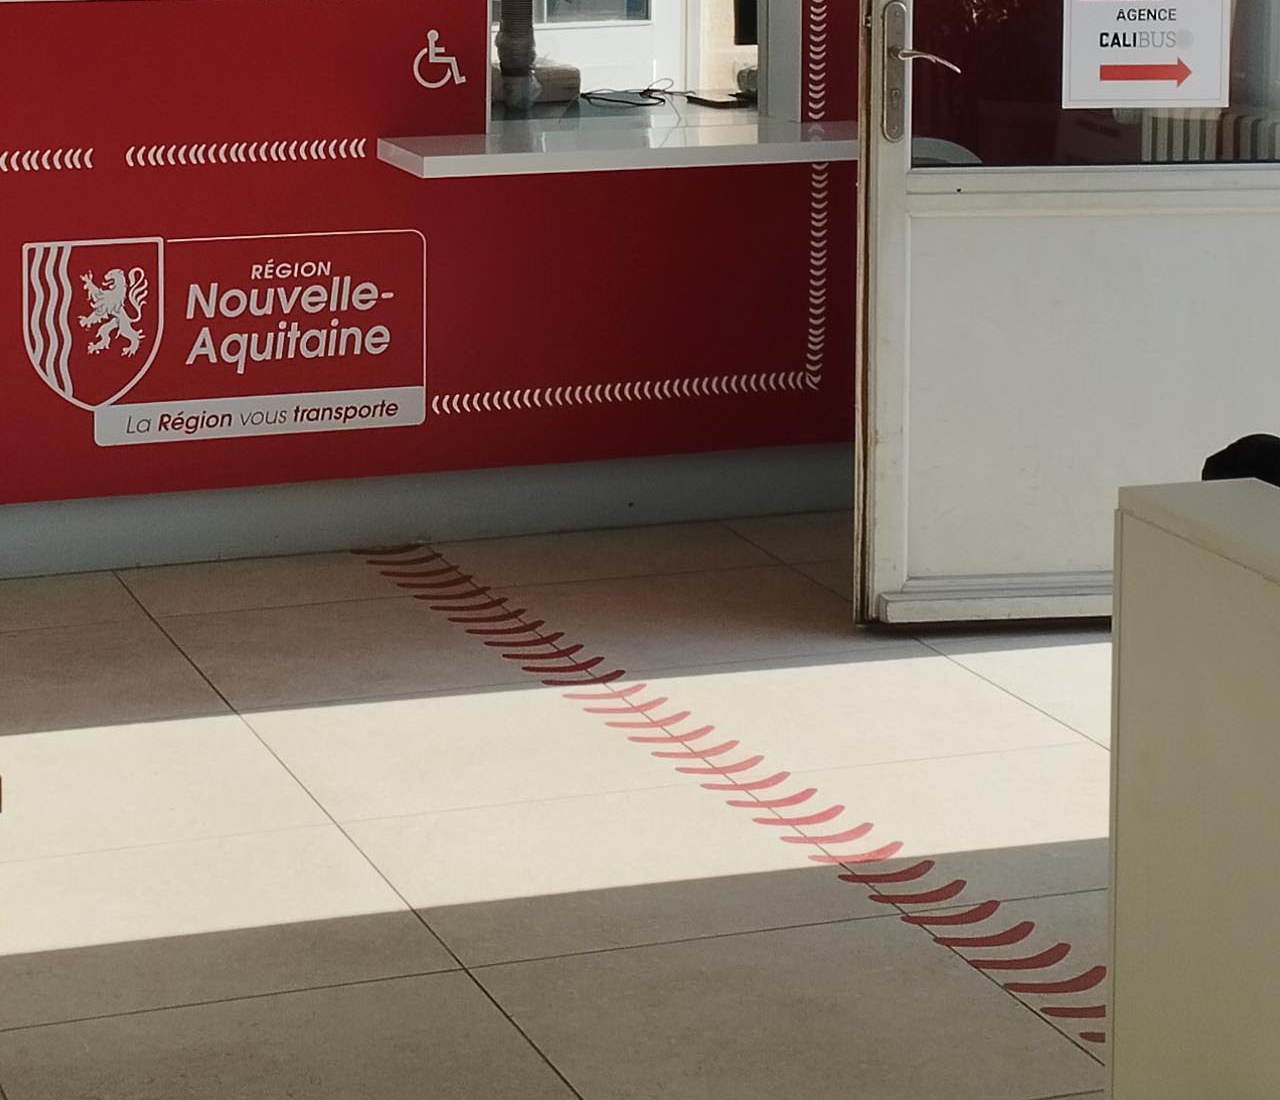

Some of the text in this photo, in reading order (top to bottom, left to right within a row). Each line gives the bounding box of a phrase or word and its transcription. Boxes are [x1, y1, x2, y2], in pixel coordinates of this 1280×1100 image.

[1116, 8, 1176, 21] AGENCE
[1099, 31, 1177, 48] CALIBUS
[251, 259, 331, 279] RÉGION
[186, 276, 394, 320] Nouvelle-
[185, 318, 391, 375] Aquitaine
[126, 400, 399, 435] La Région vous transporte
